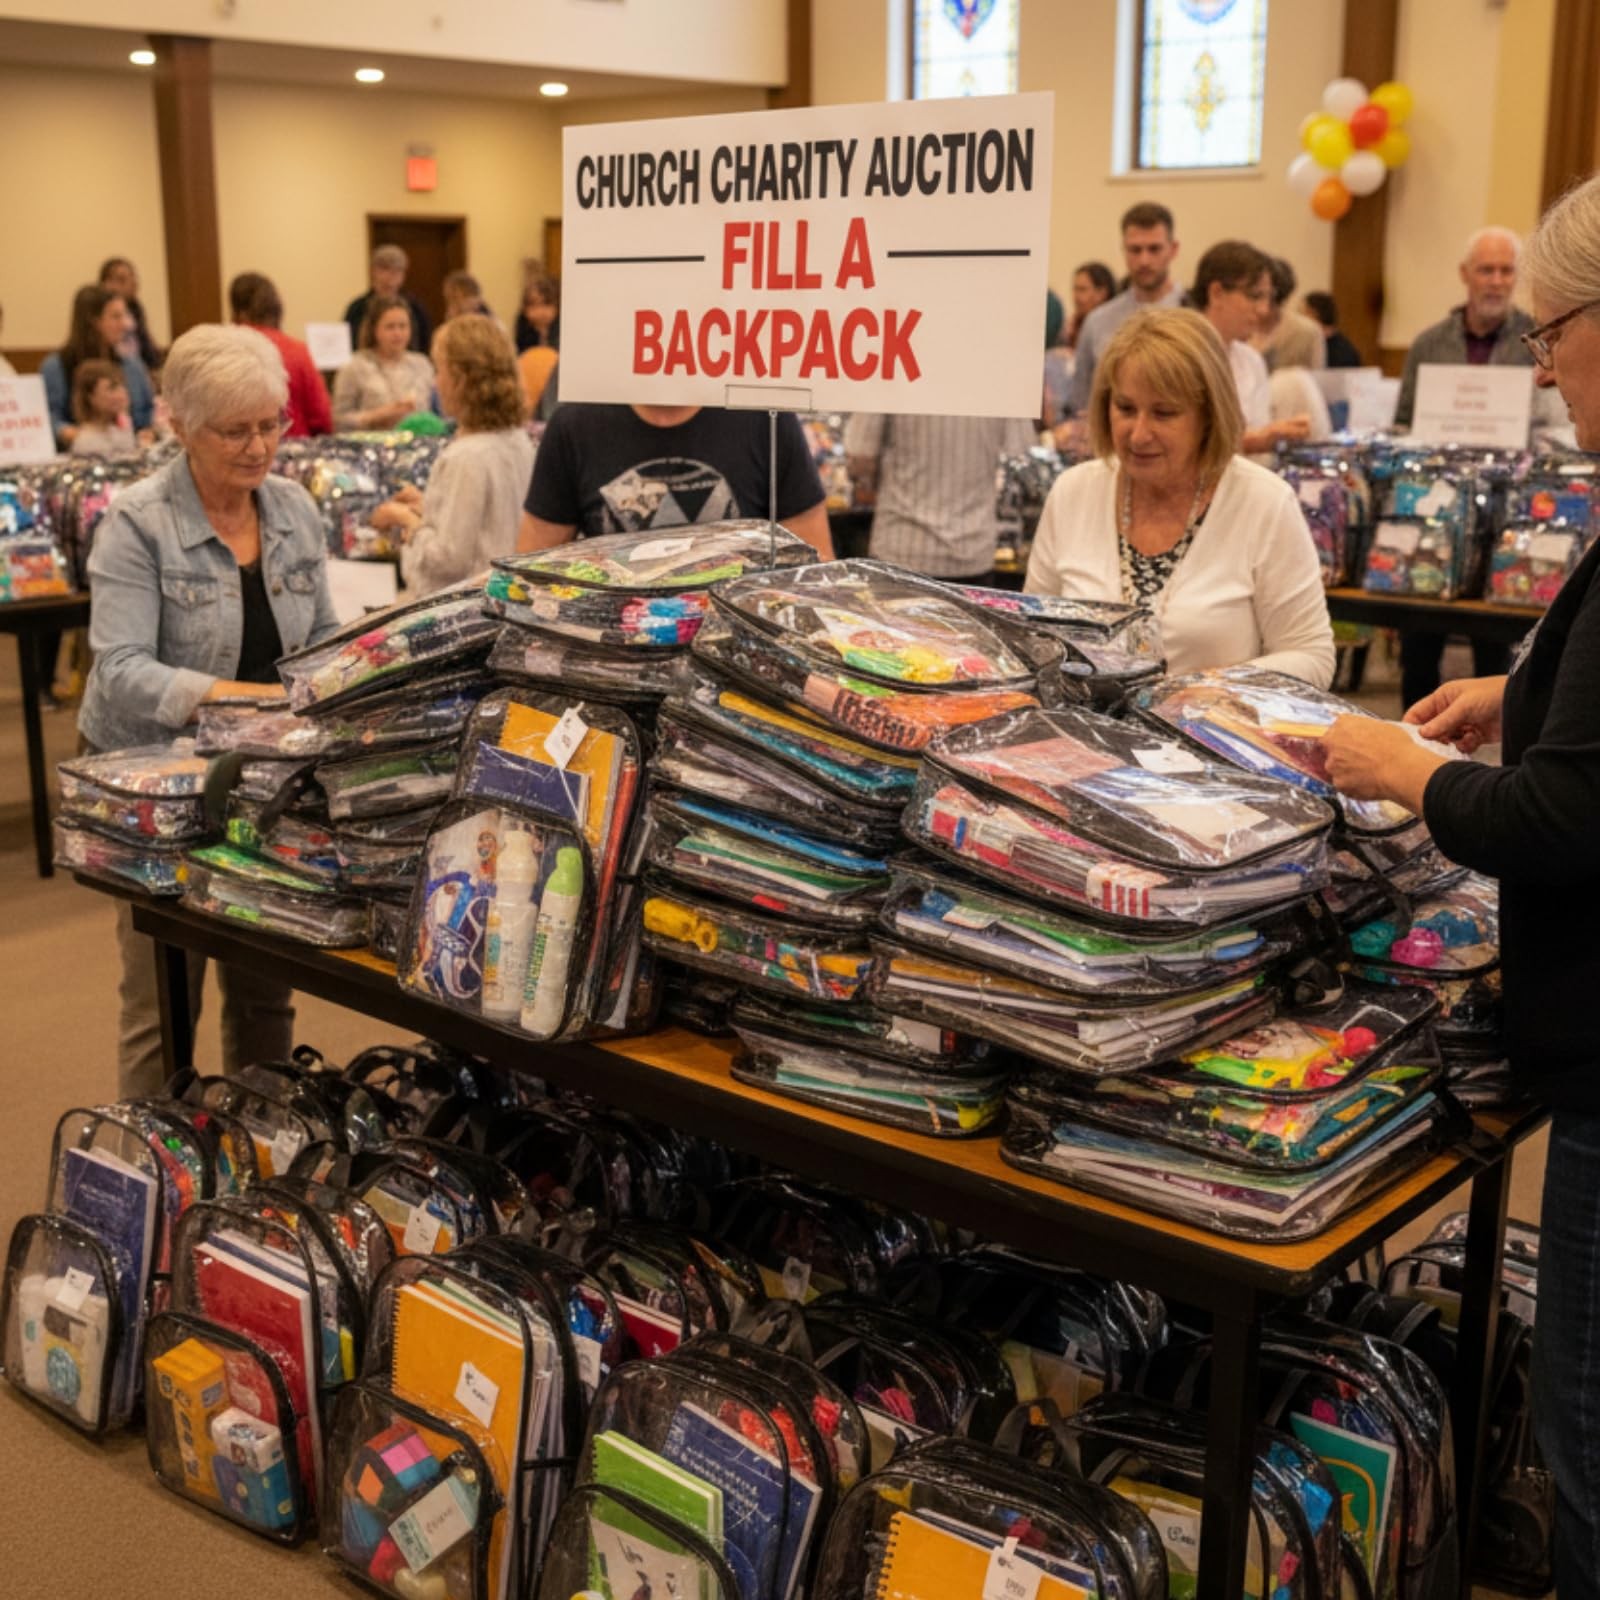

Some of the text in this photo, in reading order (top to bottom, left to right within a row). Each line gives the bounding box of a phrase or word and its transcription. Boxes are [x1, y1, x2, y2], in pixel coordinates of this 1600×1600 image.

[577, 128, 1035, 209] CHURCH CHARITY AUCTION
[722, 217, 875, 290] FILL A
[633, 308, 922, 382] BACKPACK
